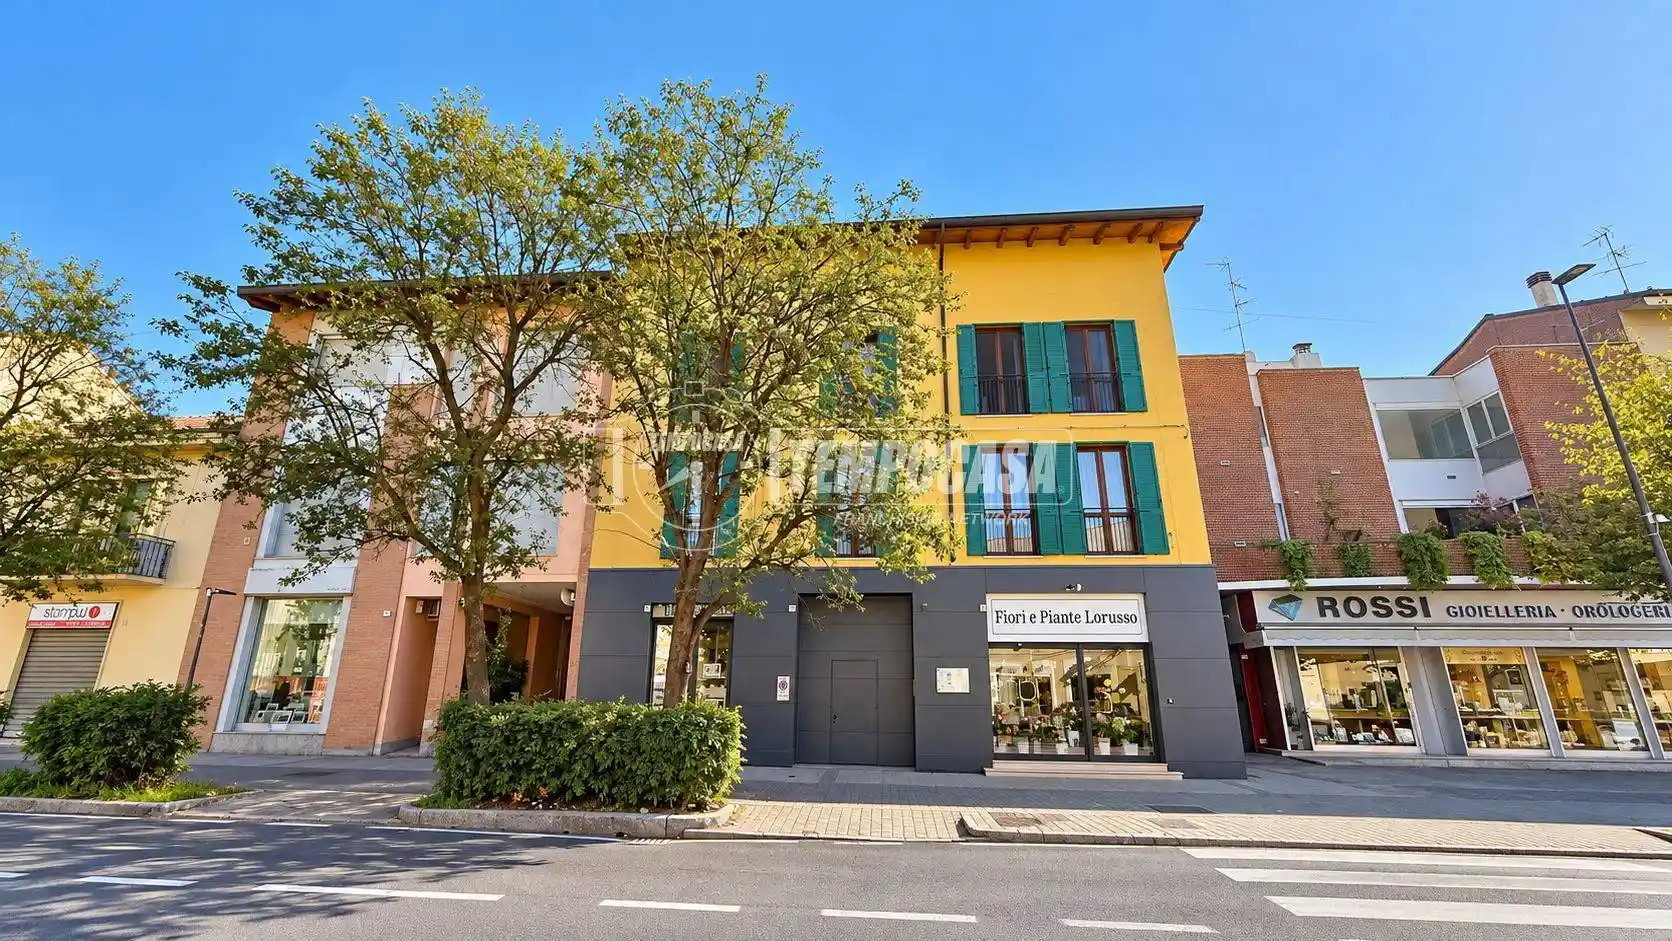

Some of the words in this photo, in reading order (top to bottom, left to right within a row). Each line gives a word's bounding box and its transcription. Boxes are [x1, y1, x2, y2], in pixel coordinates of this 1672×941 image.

[1316, 595, 1432, 619] ROSSI
[1446, 604, 1557, 619] GIOIELLERIA
[995, 609, 1027, 625] Fiori
[1029, 613, 1037, 624] e
[1039, 609, 1082, 625] Piante
[1084, 609, 1138, 625] Lorusso
